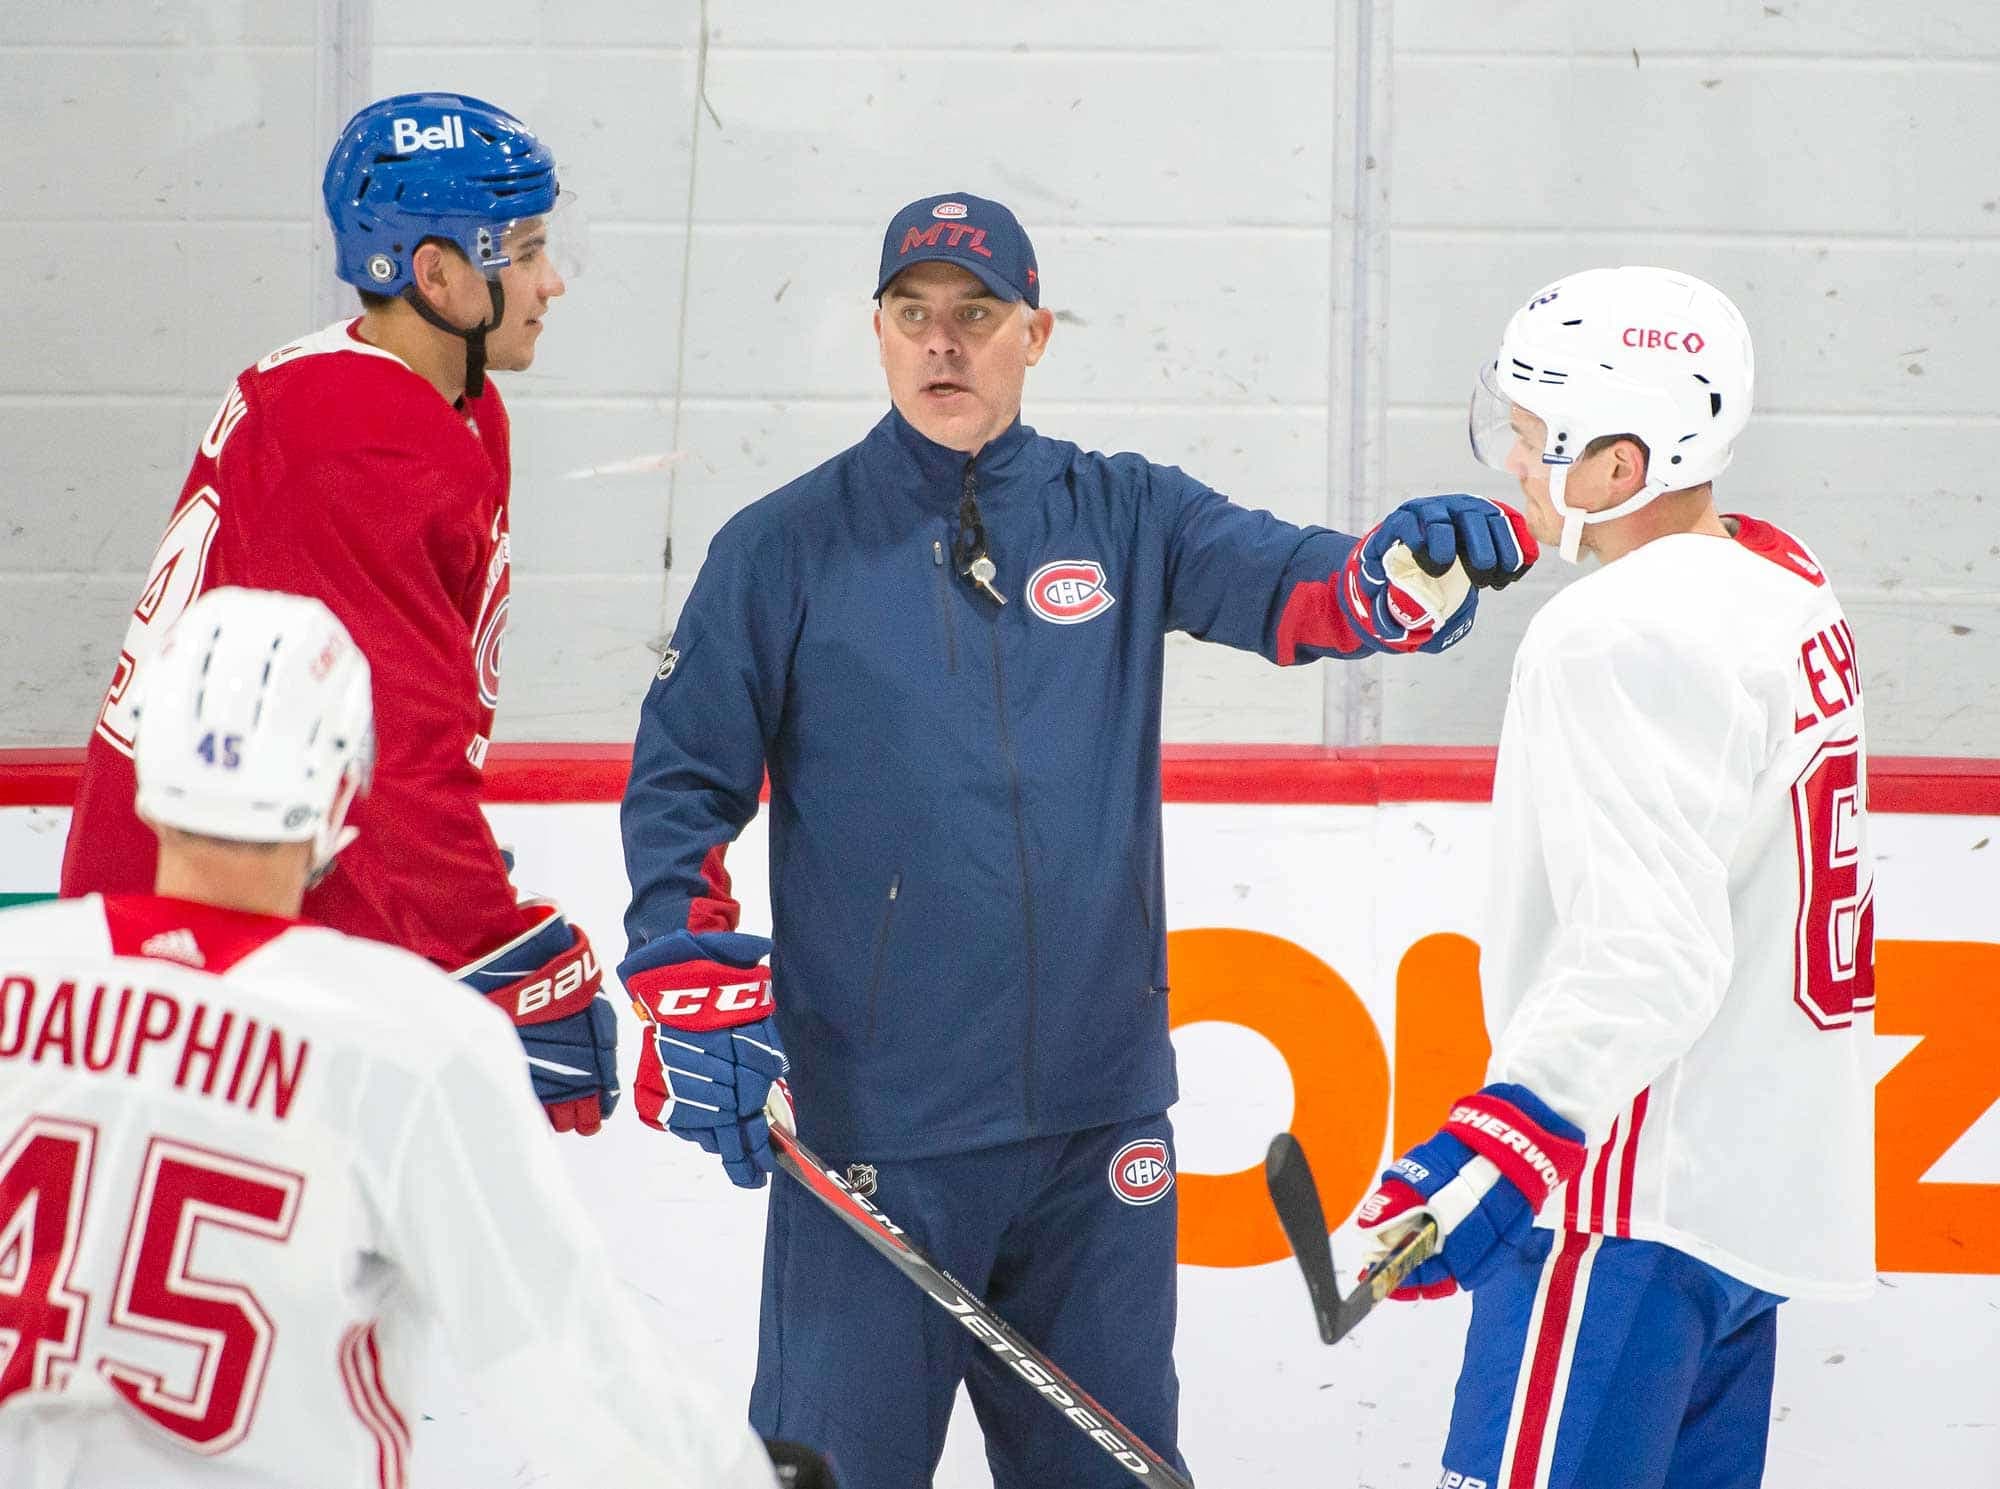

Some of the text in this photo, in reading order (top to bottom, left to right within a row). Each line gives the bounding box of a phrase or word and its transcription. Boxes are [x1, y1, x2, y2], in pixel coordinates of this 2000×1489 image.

[393, 115, 465, 154] Bell
[899, 222, 992, 259] MTL
[1622, 327, 1679, 350] CIBC
[197, 731, 242, 769] 45
[0, 976, 310, 1119] DAUPHIN
[826, 1170, 904, 1234] CCM
[0, 1113, 307, 1457] 45
[928, 1290, 1149, 1475] JETSPEED
